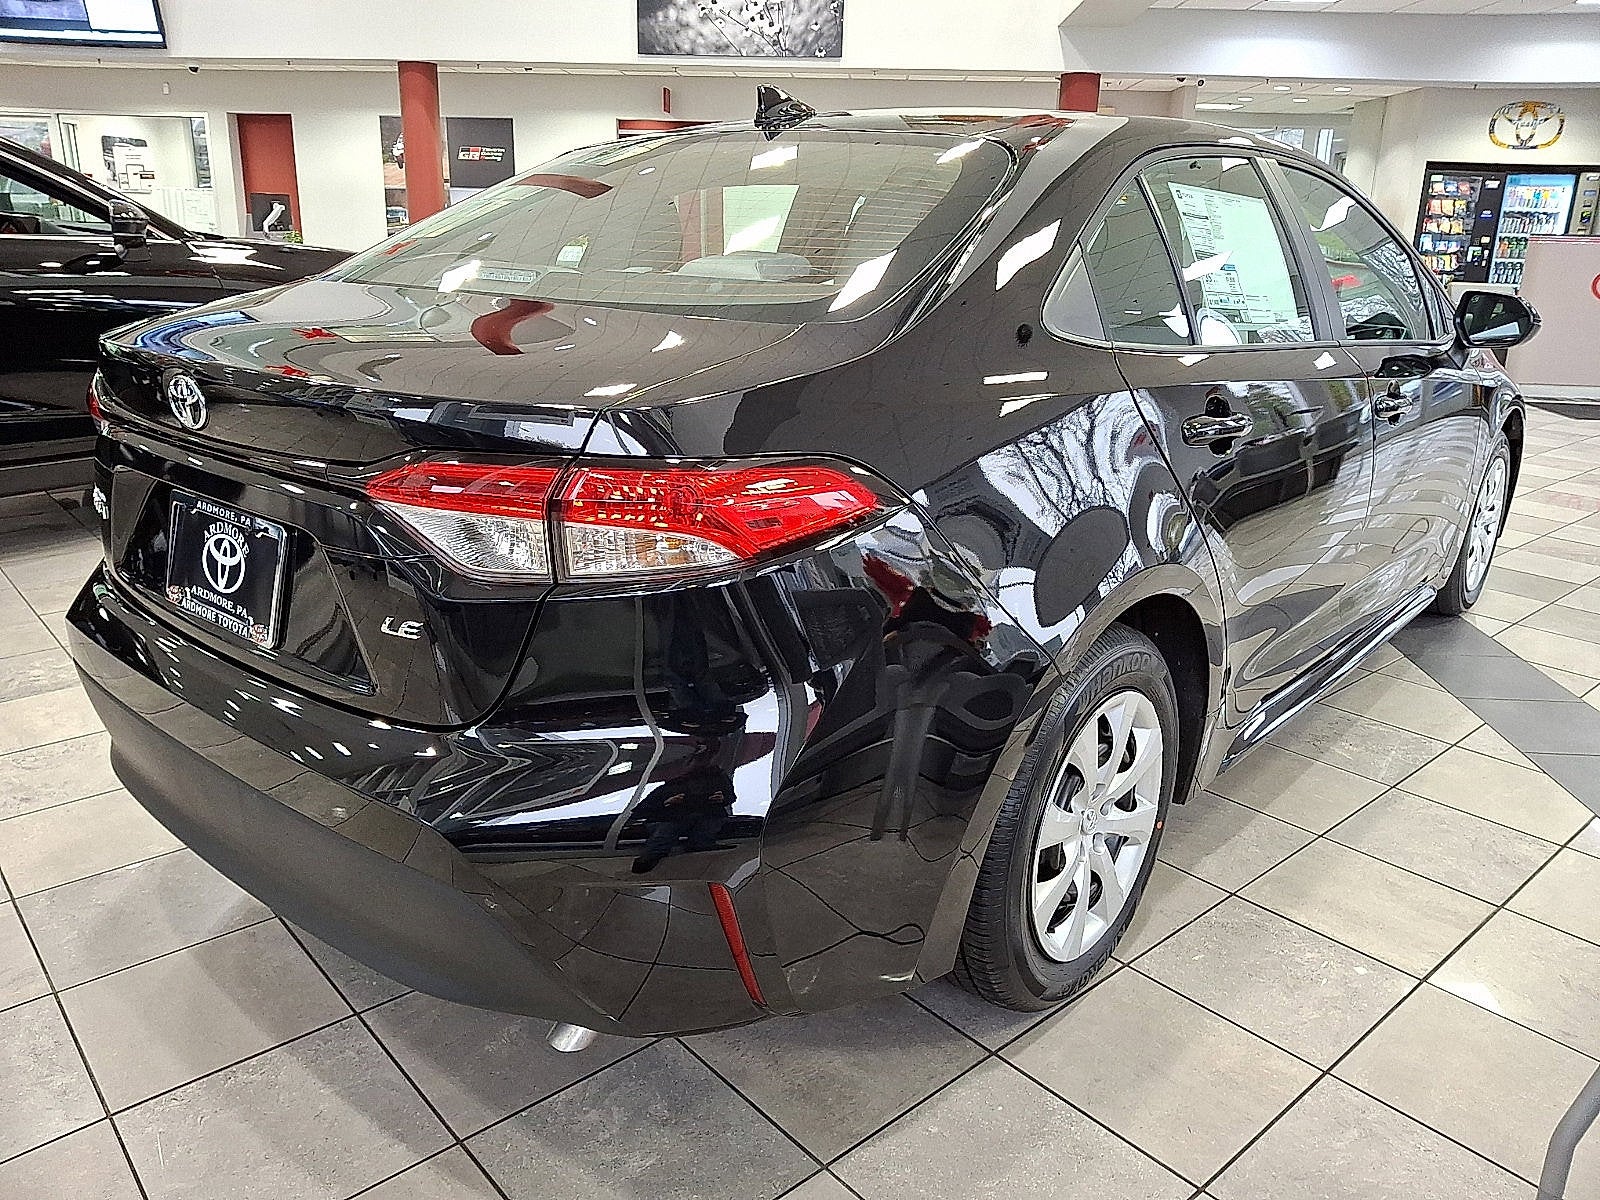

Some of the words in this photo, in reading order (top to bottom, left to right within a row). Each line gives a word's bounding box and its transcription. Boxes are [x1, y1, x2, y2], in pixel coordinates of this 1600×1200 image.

[196, 500, 238, 523] ARDMORE,
[240, 515, 252, 527] PA
[203, 521, 251, 558] ARDMORE
[181, 599, 217, 623] ARDMORE
[218, 614, 249, 638] TOYOTA
[190, 584, 236, 615] ARDMORE,
[236, 604, 249, 619] PA
[381, 616, 424, 640] LE
